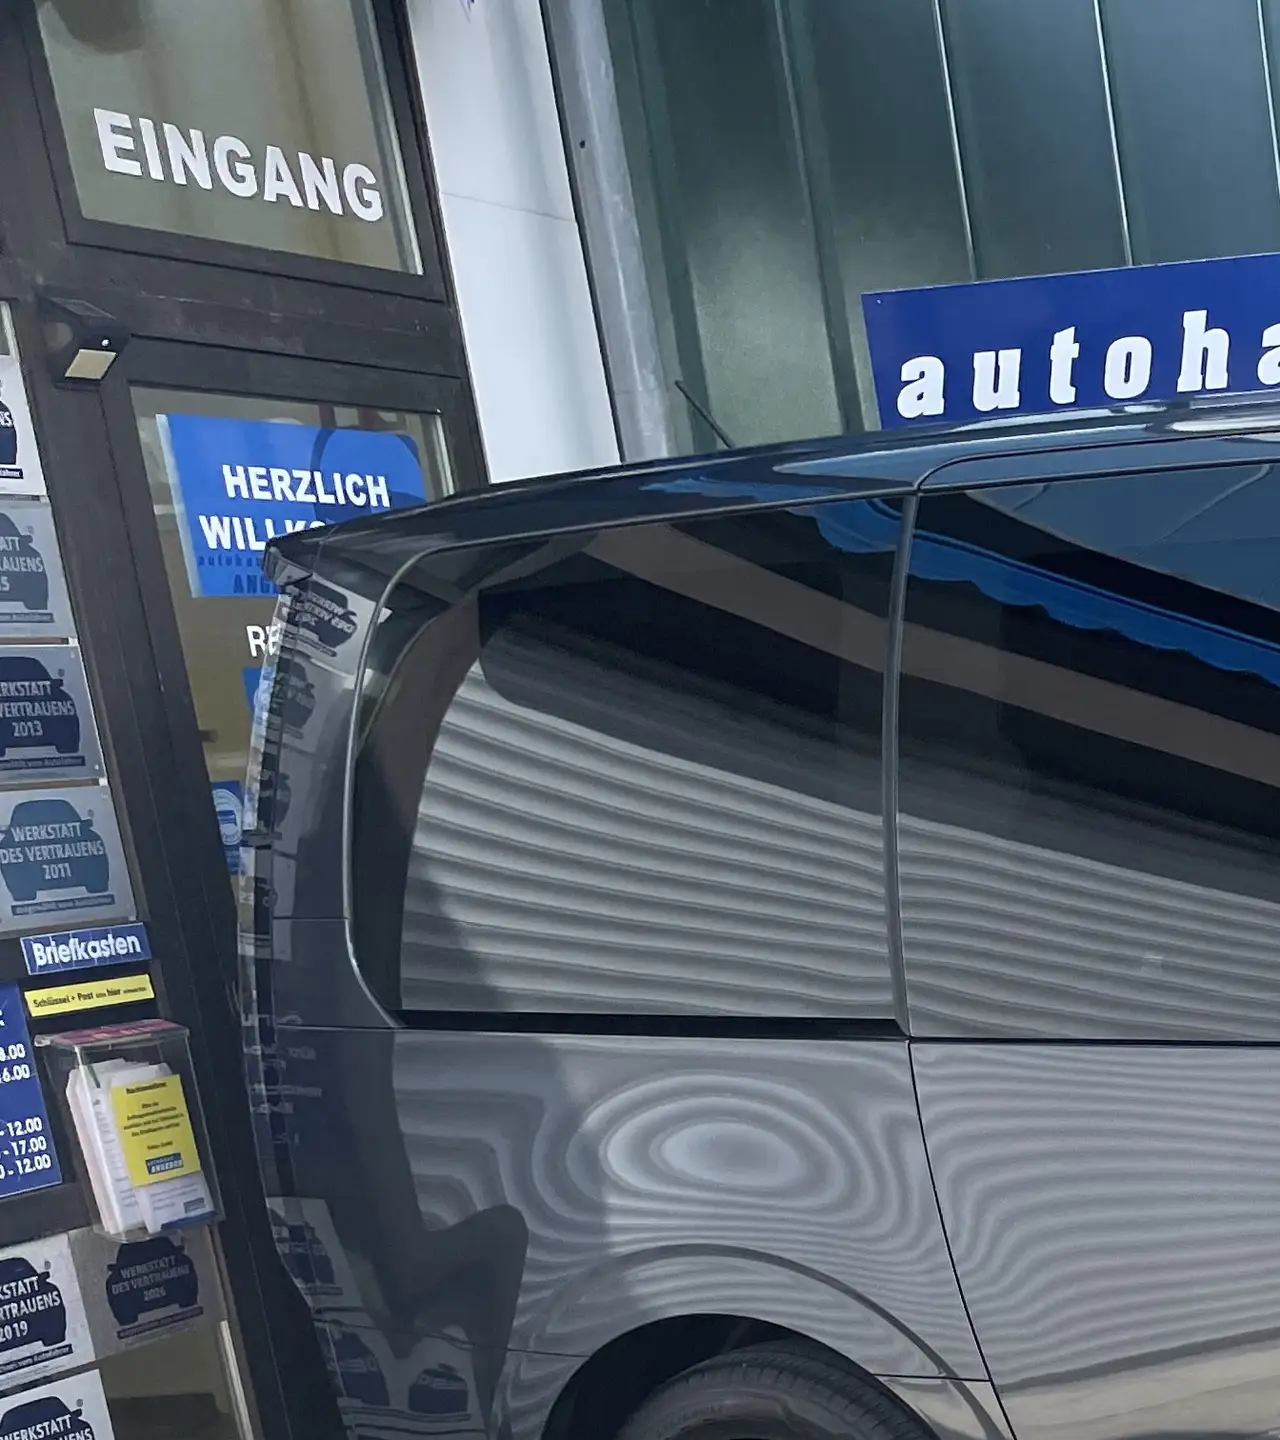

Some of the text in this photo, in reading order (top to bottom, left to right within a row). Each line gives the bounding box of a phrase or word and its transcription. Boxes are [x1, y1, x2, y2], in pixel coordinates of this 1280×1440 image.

[93, 107, 384, 222] EINGANG
[221, 463, 390, 508] HERZLICH
[198, 515, 326, 551] WILL
[12, 720, 43, 737] 2013
[11, 822, 82, 842] WERKSTATT
[0, 840, 105, 864] DES VERTRAUENS
[42, 863, 72, 880] 2011
[31, 933, 142, 966] Briefkasten
[7, 1117, 42, 1137] 12.00
[11, 1135, 47, 1156] 17.00
[16, 1154, 52, 1175] 12.00
[0, 1320, 28, 1343] 2019
